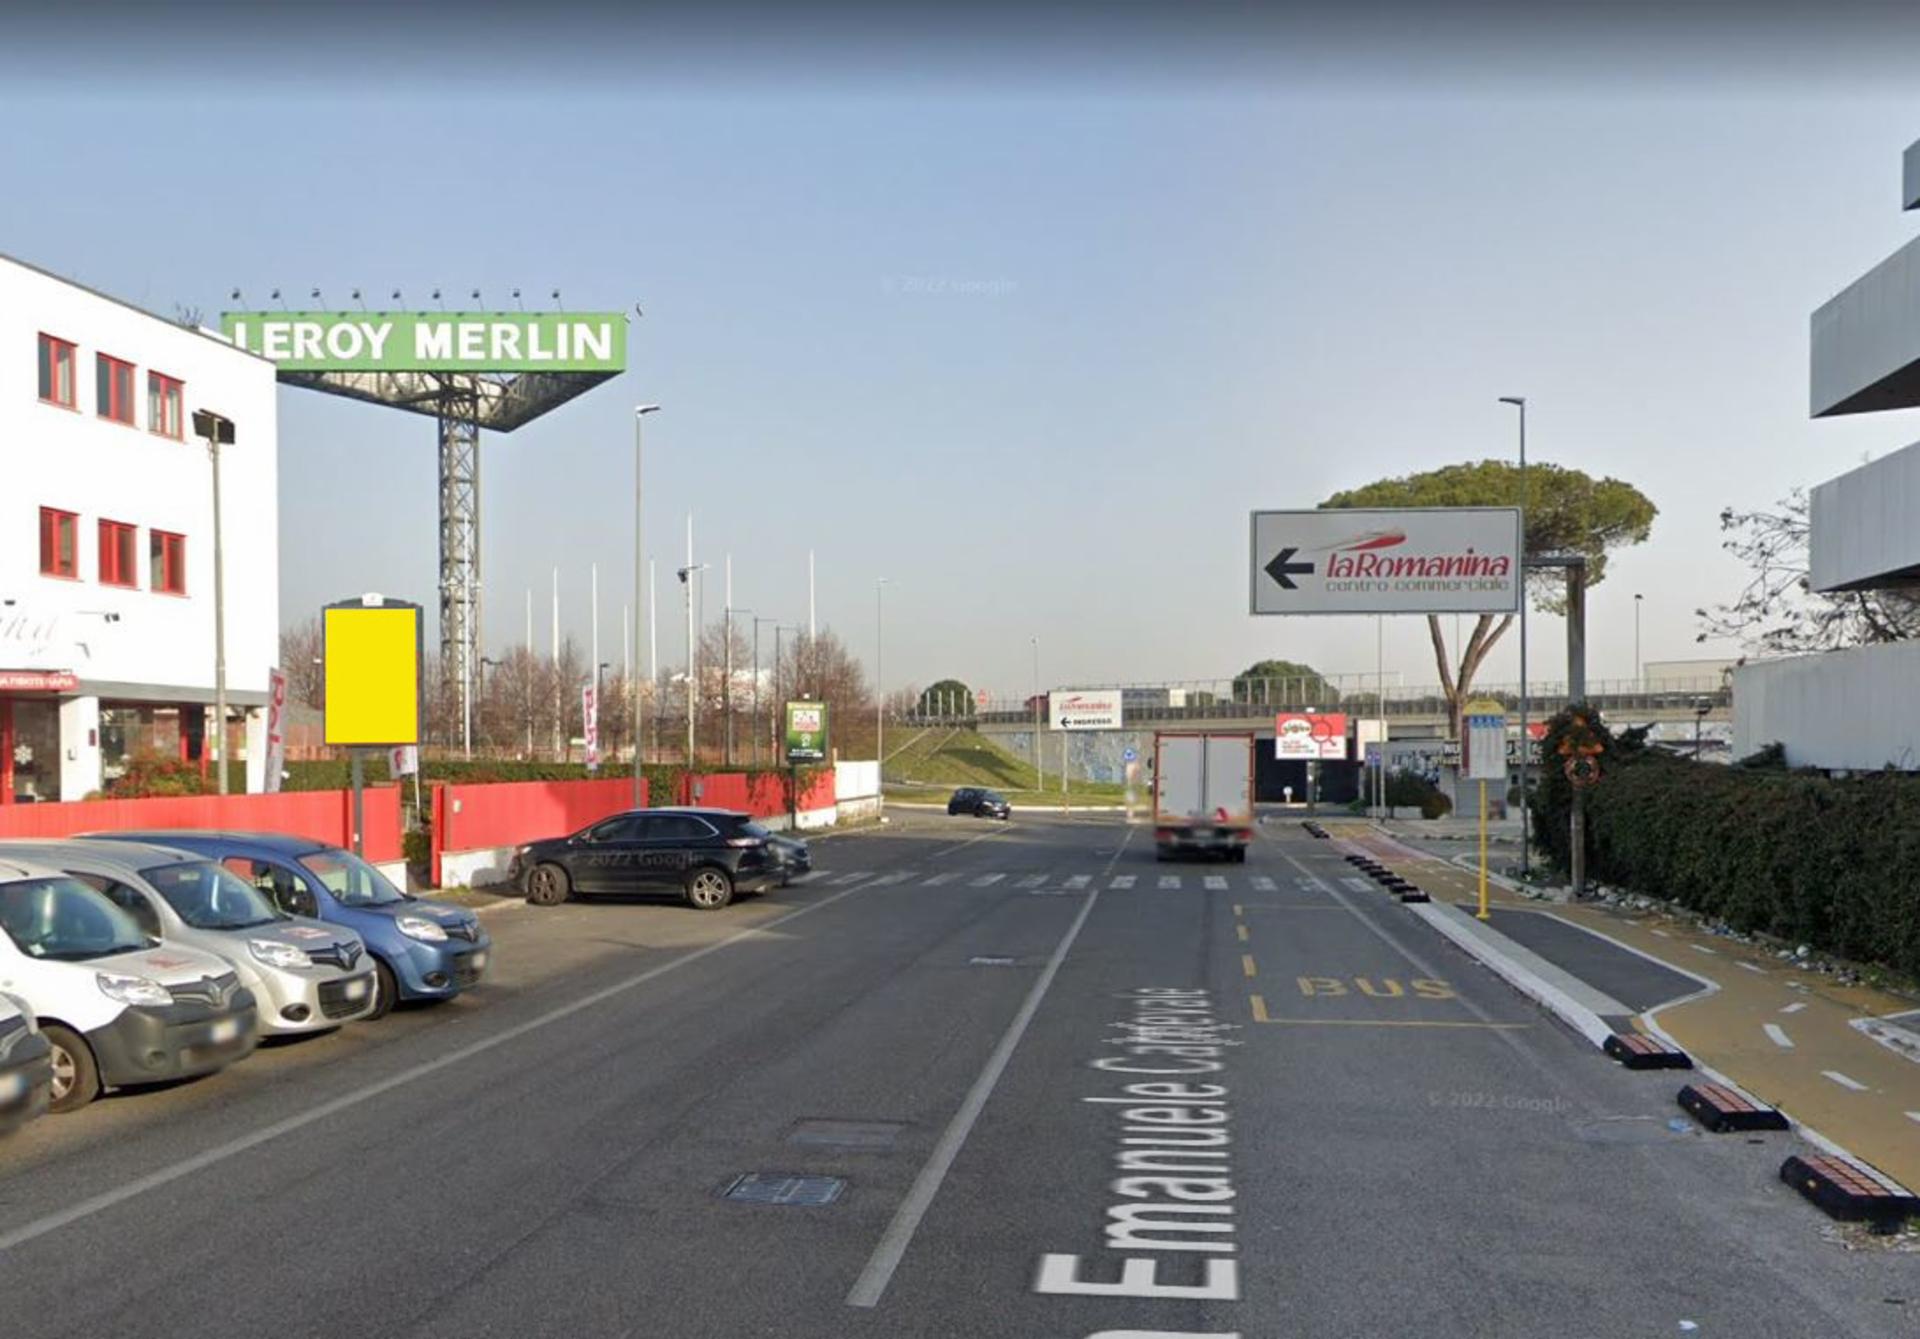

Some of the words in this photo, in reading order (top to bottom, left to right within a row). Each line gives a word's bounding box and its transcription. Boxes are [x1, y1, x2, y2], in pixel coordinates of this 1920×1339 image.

[235, 322, 393, 360] LEROY
[414, 322, 612, 360] MERLIN
[1326, 548, 1511, 578] laRomanina
[1325, 579, 1389, 592] centro
[1394, 578, 1509, 592] commerciale
[1297, 977, 1457, 999] BUS
